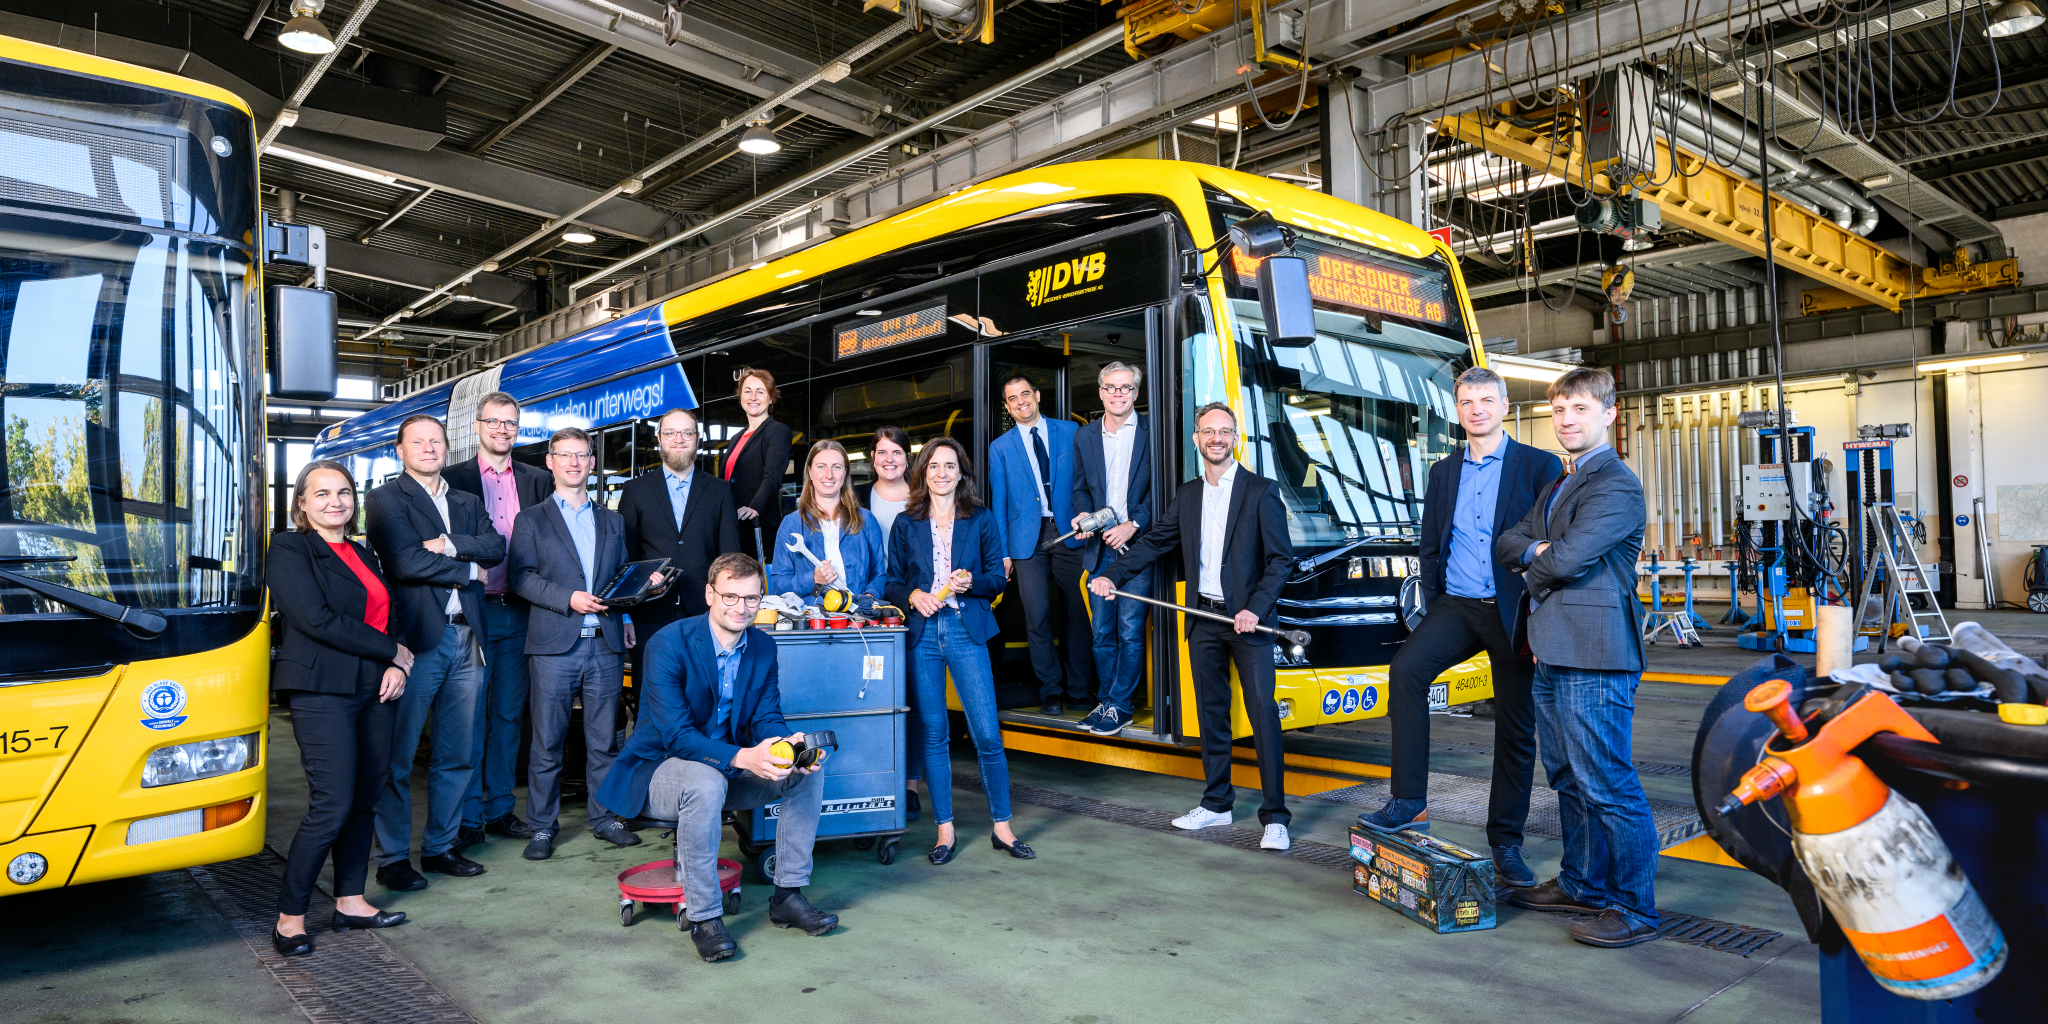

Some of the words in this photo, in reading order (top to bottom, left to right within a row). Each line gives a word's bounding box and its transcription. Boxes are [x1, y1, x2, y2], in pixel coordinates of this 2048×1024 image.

[1052, 252, 1106, 291] DVB
[1318, 255, 1411, 296] DRESDNER
[2000, 264, 2011, 278] C
[1309, 274, 1422, 318] RKEHRSBETRIEBE
[1426, 301, 1442, 322] AG
[1803, 294, 1813, 307] D
[882, 317, 901, 332] DVB
[905, 313, 918, 327] AG
[862, 320, 941, 351] Aktiengesellschaft
[590, 374, 664, 421] unterwegs!
[1845, 441, 1887, 449] HYWEMA
[1456, 675, 1488, 691] 464001-3
[825, 800, 892, 813] Adjutant
